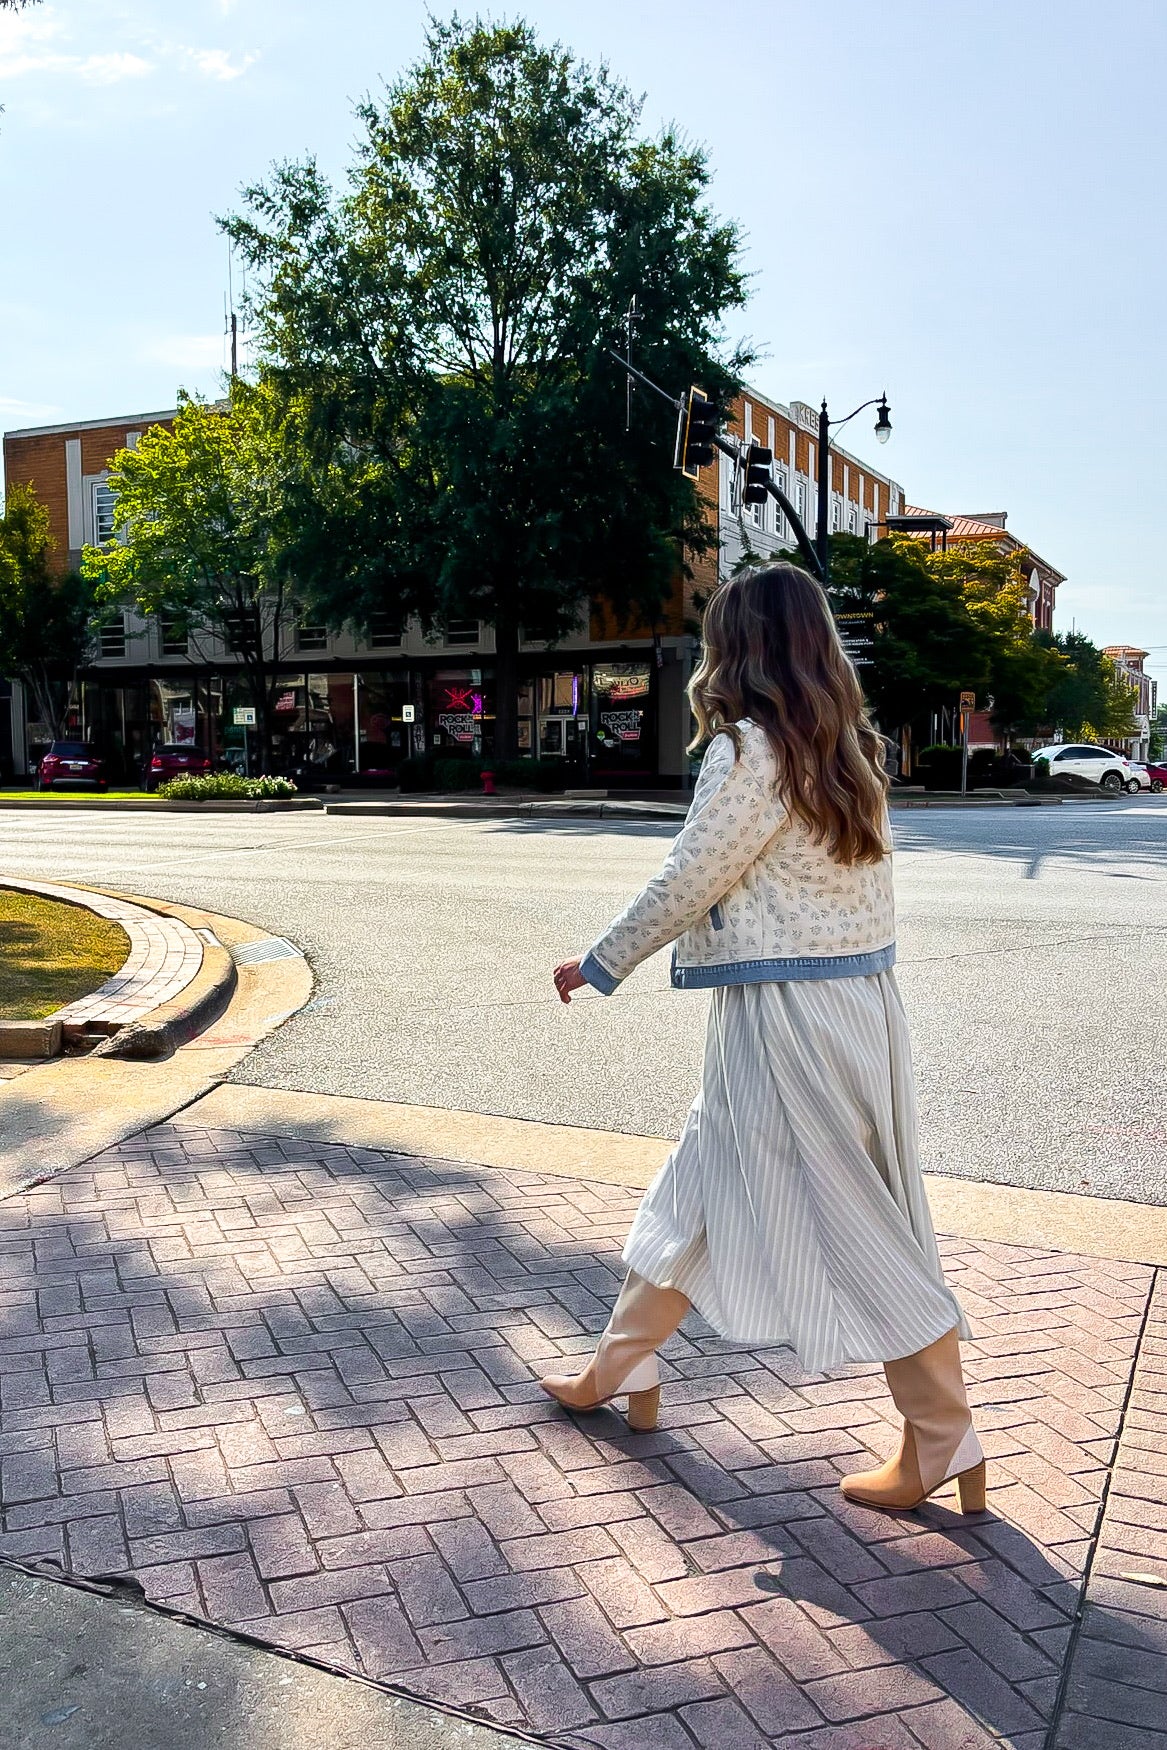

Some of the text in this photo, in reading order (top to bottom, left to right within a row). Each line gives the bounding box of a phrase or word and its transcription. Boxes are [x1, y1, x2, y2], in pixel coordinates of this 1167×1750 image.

[439, 714, 467, 724] ROCK
[601, 712, 631, 723] ROCK
[449, 723, 474, 733] ROLL
[612, 722, 640, 732] ROLL
